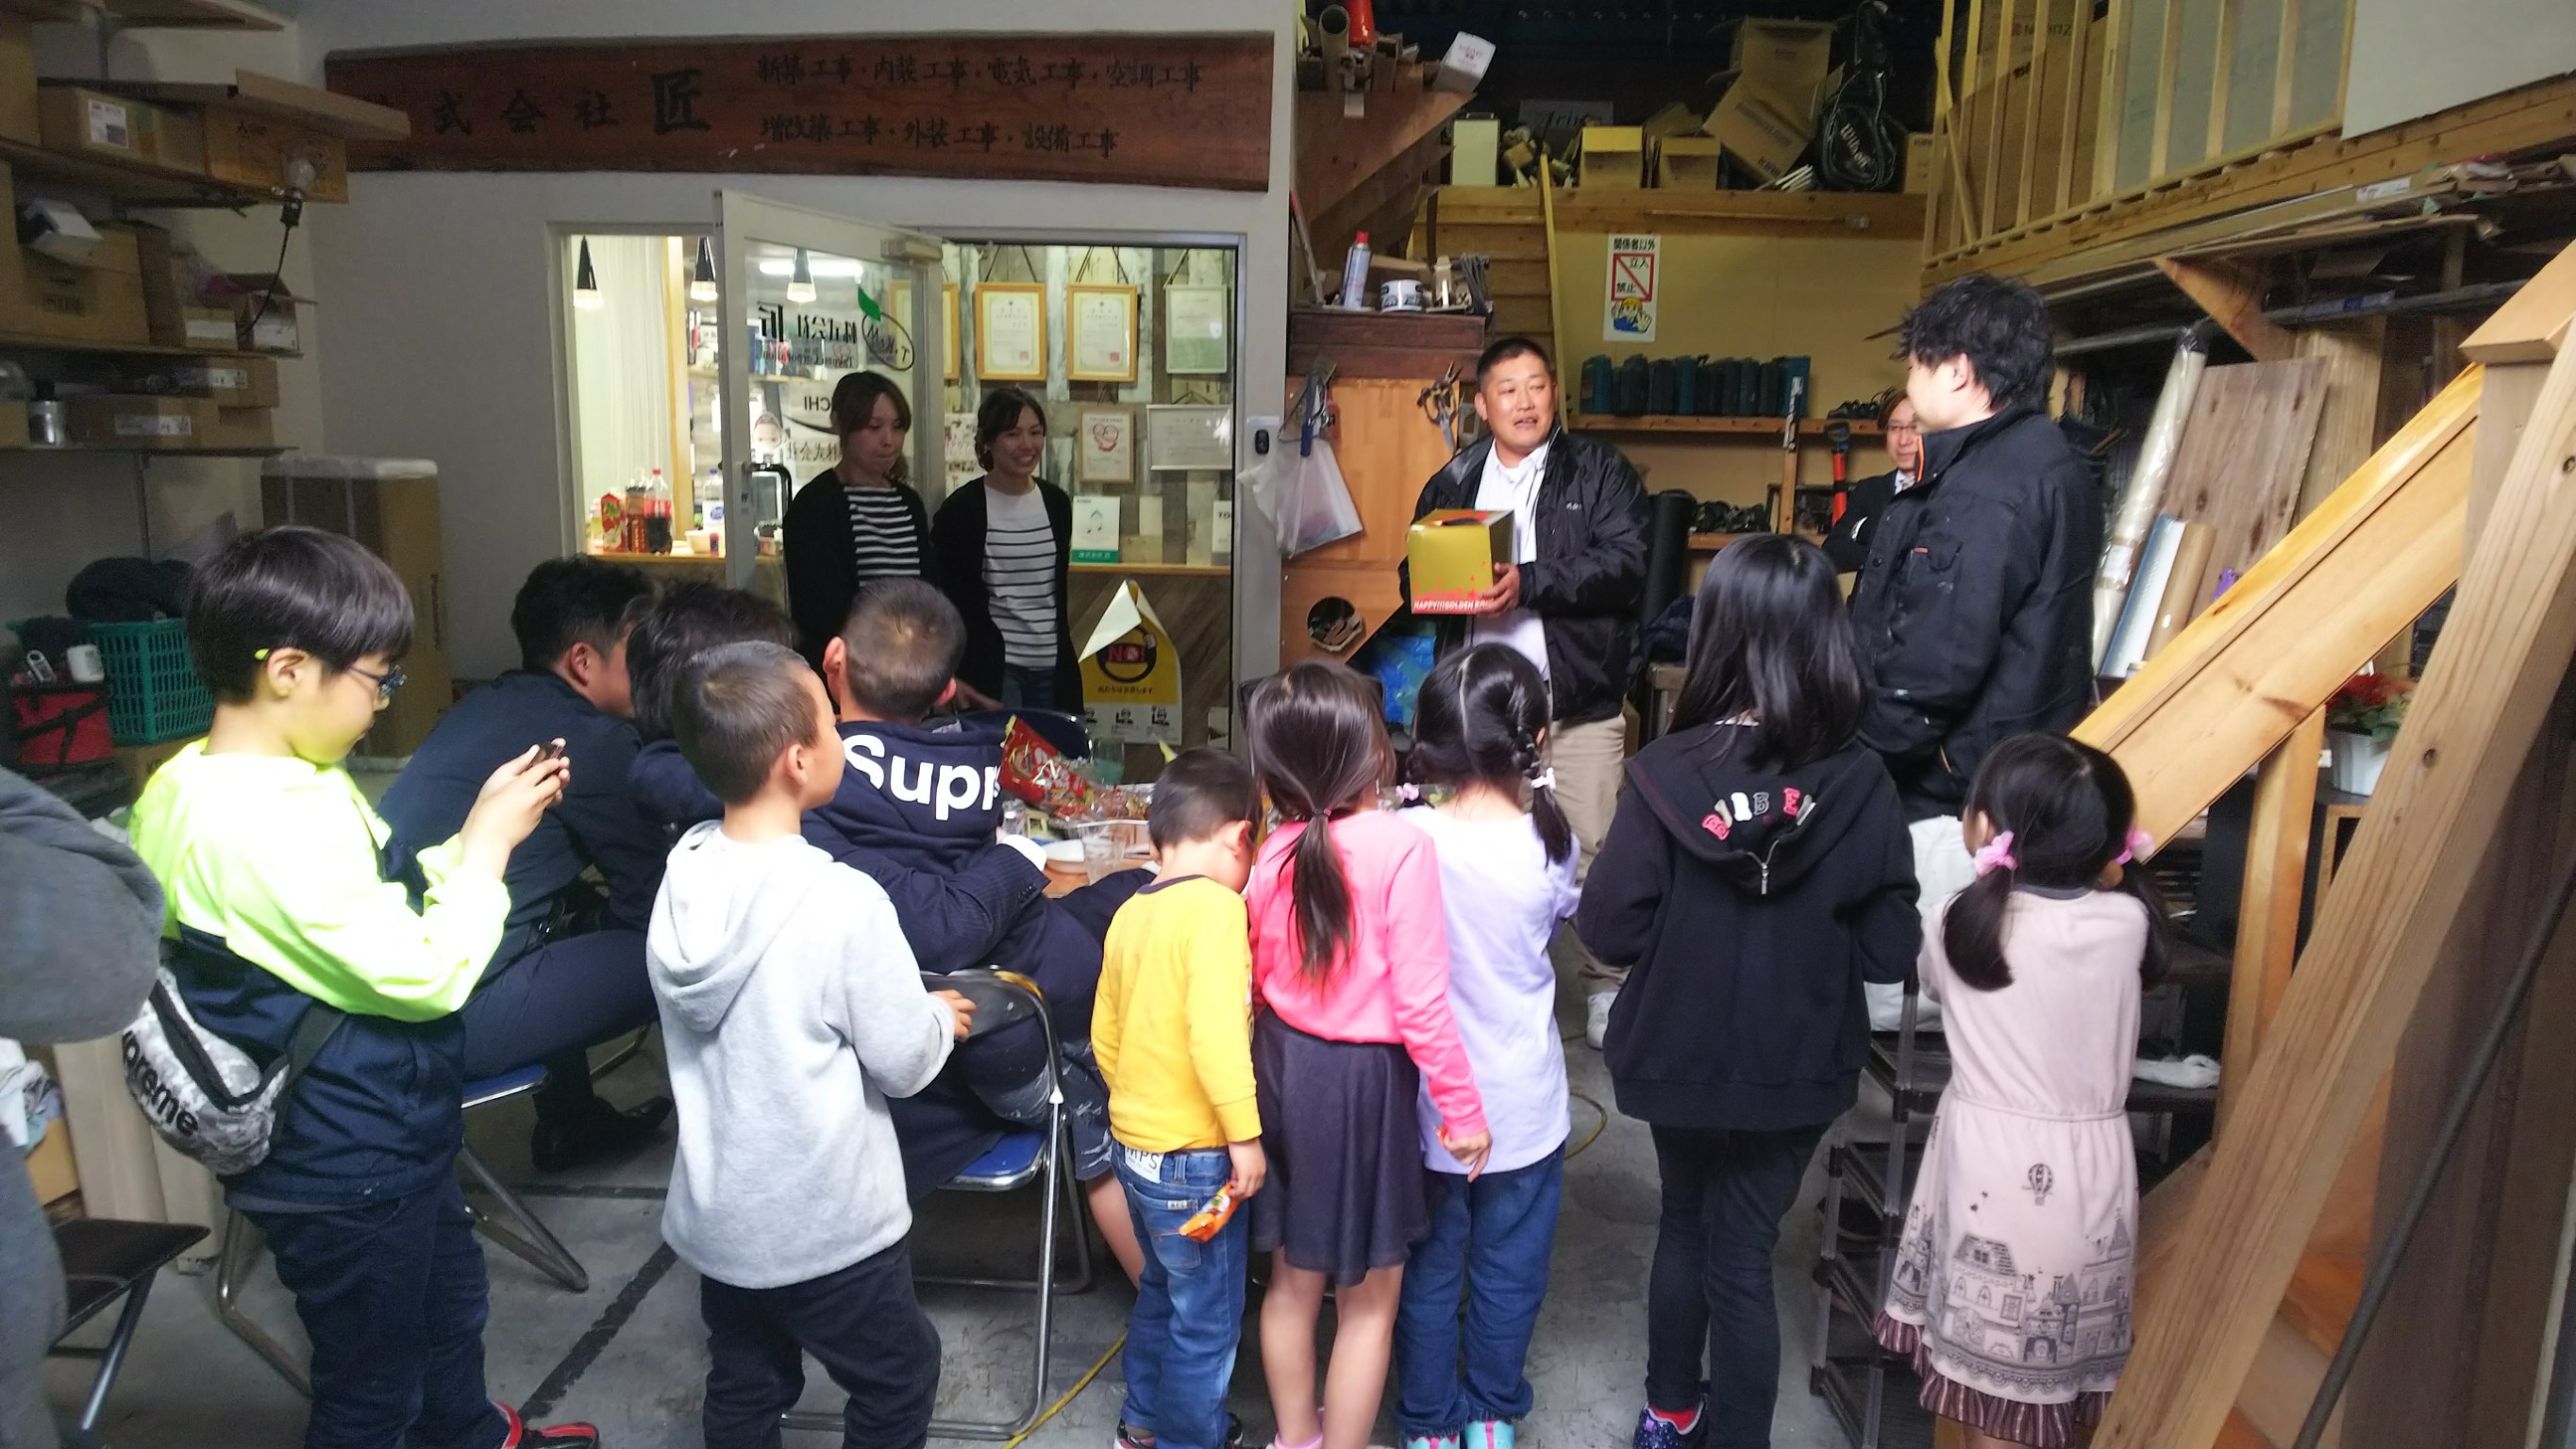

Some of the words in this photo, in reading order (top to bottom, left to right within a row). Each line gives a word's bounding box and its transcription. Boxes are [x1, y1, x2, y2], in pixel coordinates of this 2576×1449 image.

[377, 89, 619, 135] 式会社
[1614, 237, 1655, 251] 関係者以外
[1616, 281, 1636, 293] 禁止
